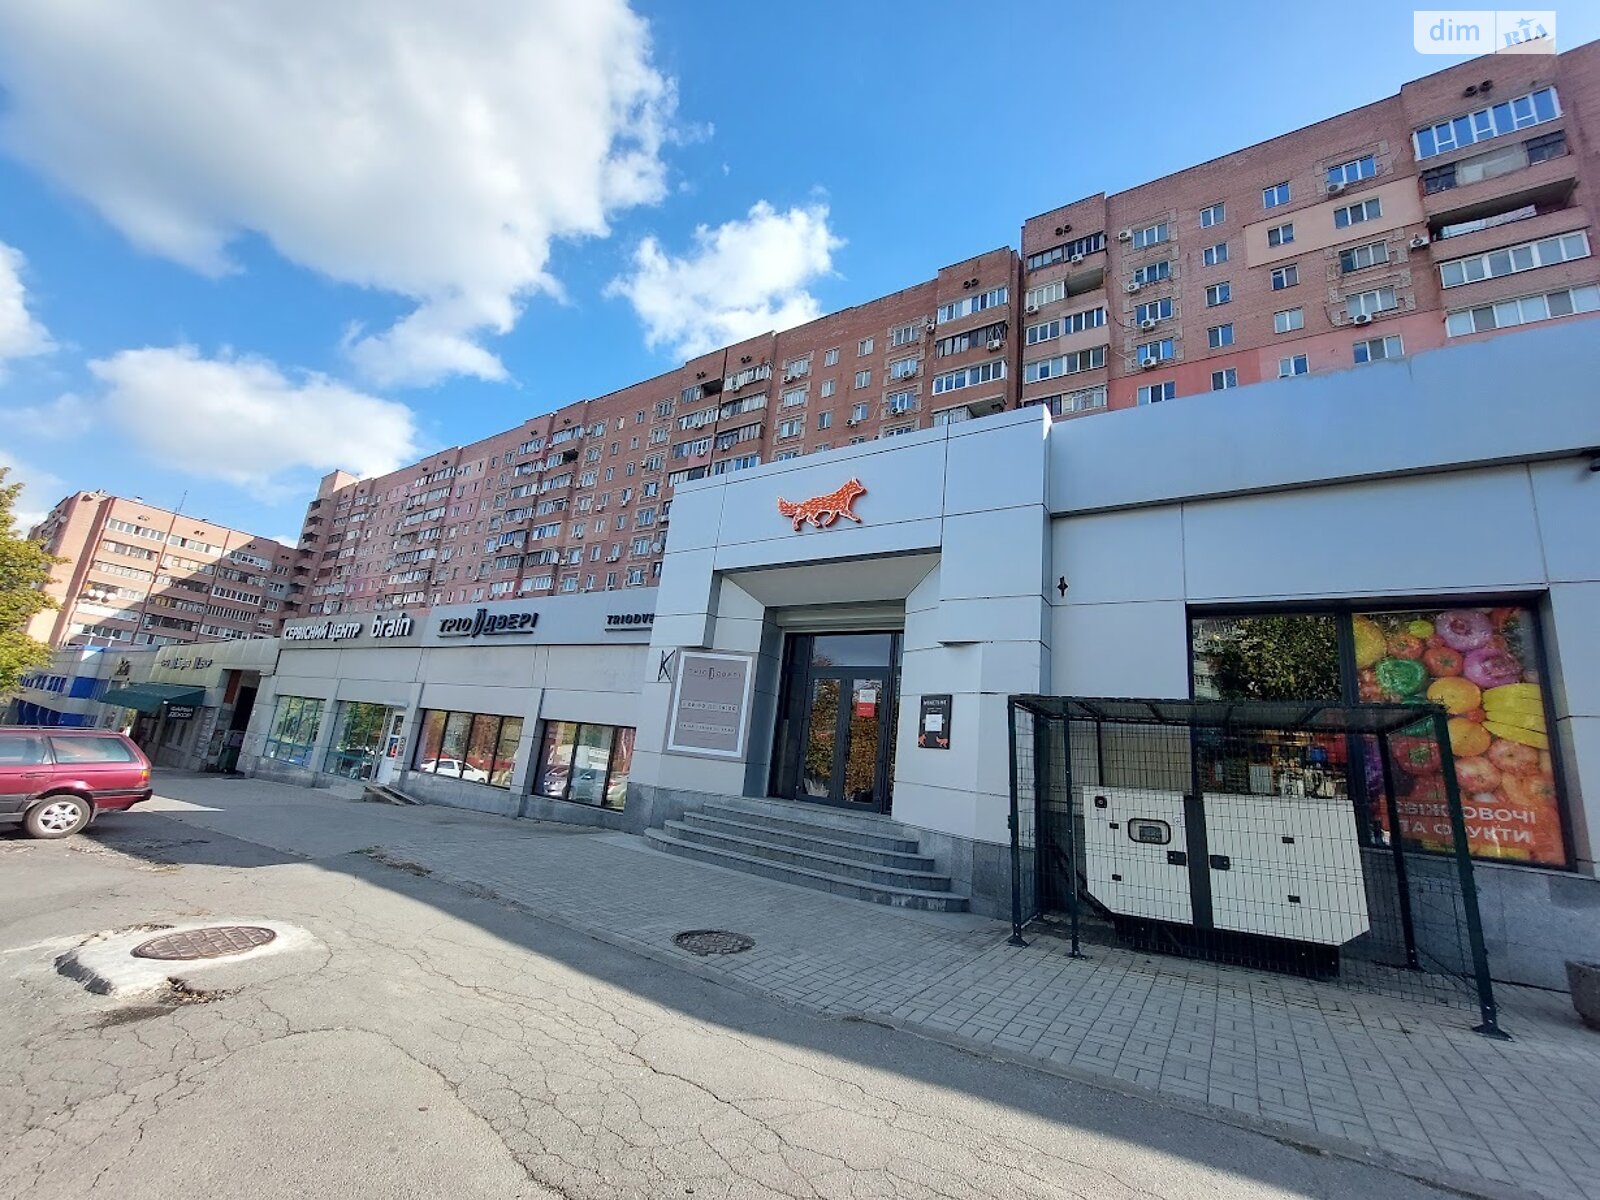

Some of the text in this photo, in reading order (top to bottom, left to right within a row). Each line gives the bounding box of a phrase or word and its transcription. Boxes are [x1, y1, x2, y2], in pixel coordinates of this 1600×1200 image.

[284, 621, 363, 642] СЕРВІСНИЙ ЦЕНТР
[369, 613, 414, 638] brain
[439, 612, 539, 632] ТРІО ДВЕРІ
[1461, 805, 1537, 825] ОВОЧІ
[1433, 823, 1534, 844] ФУКТИ
